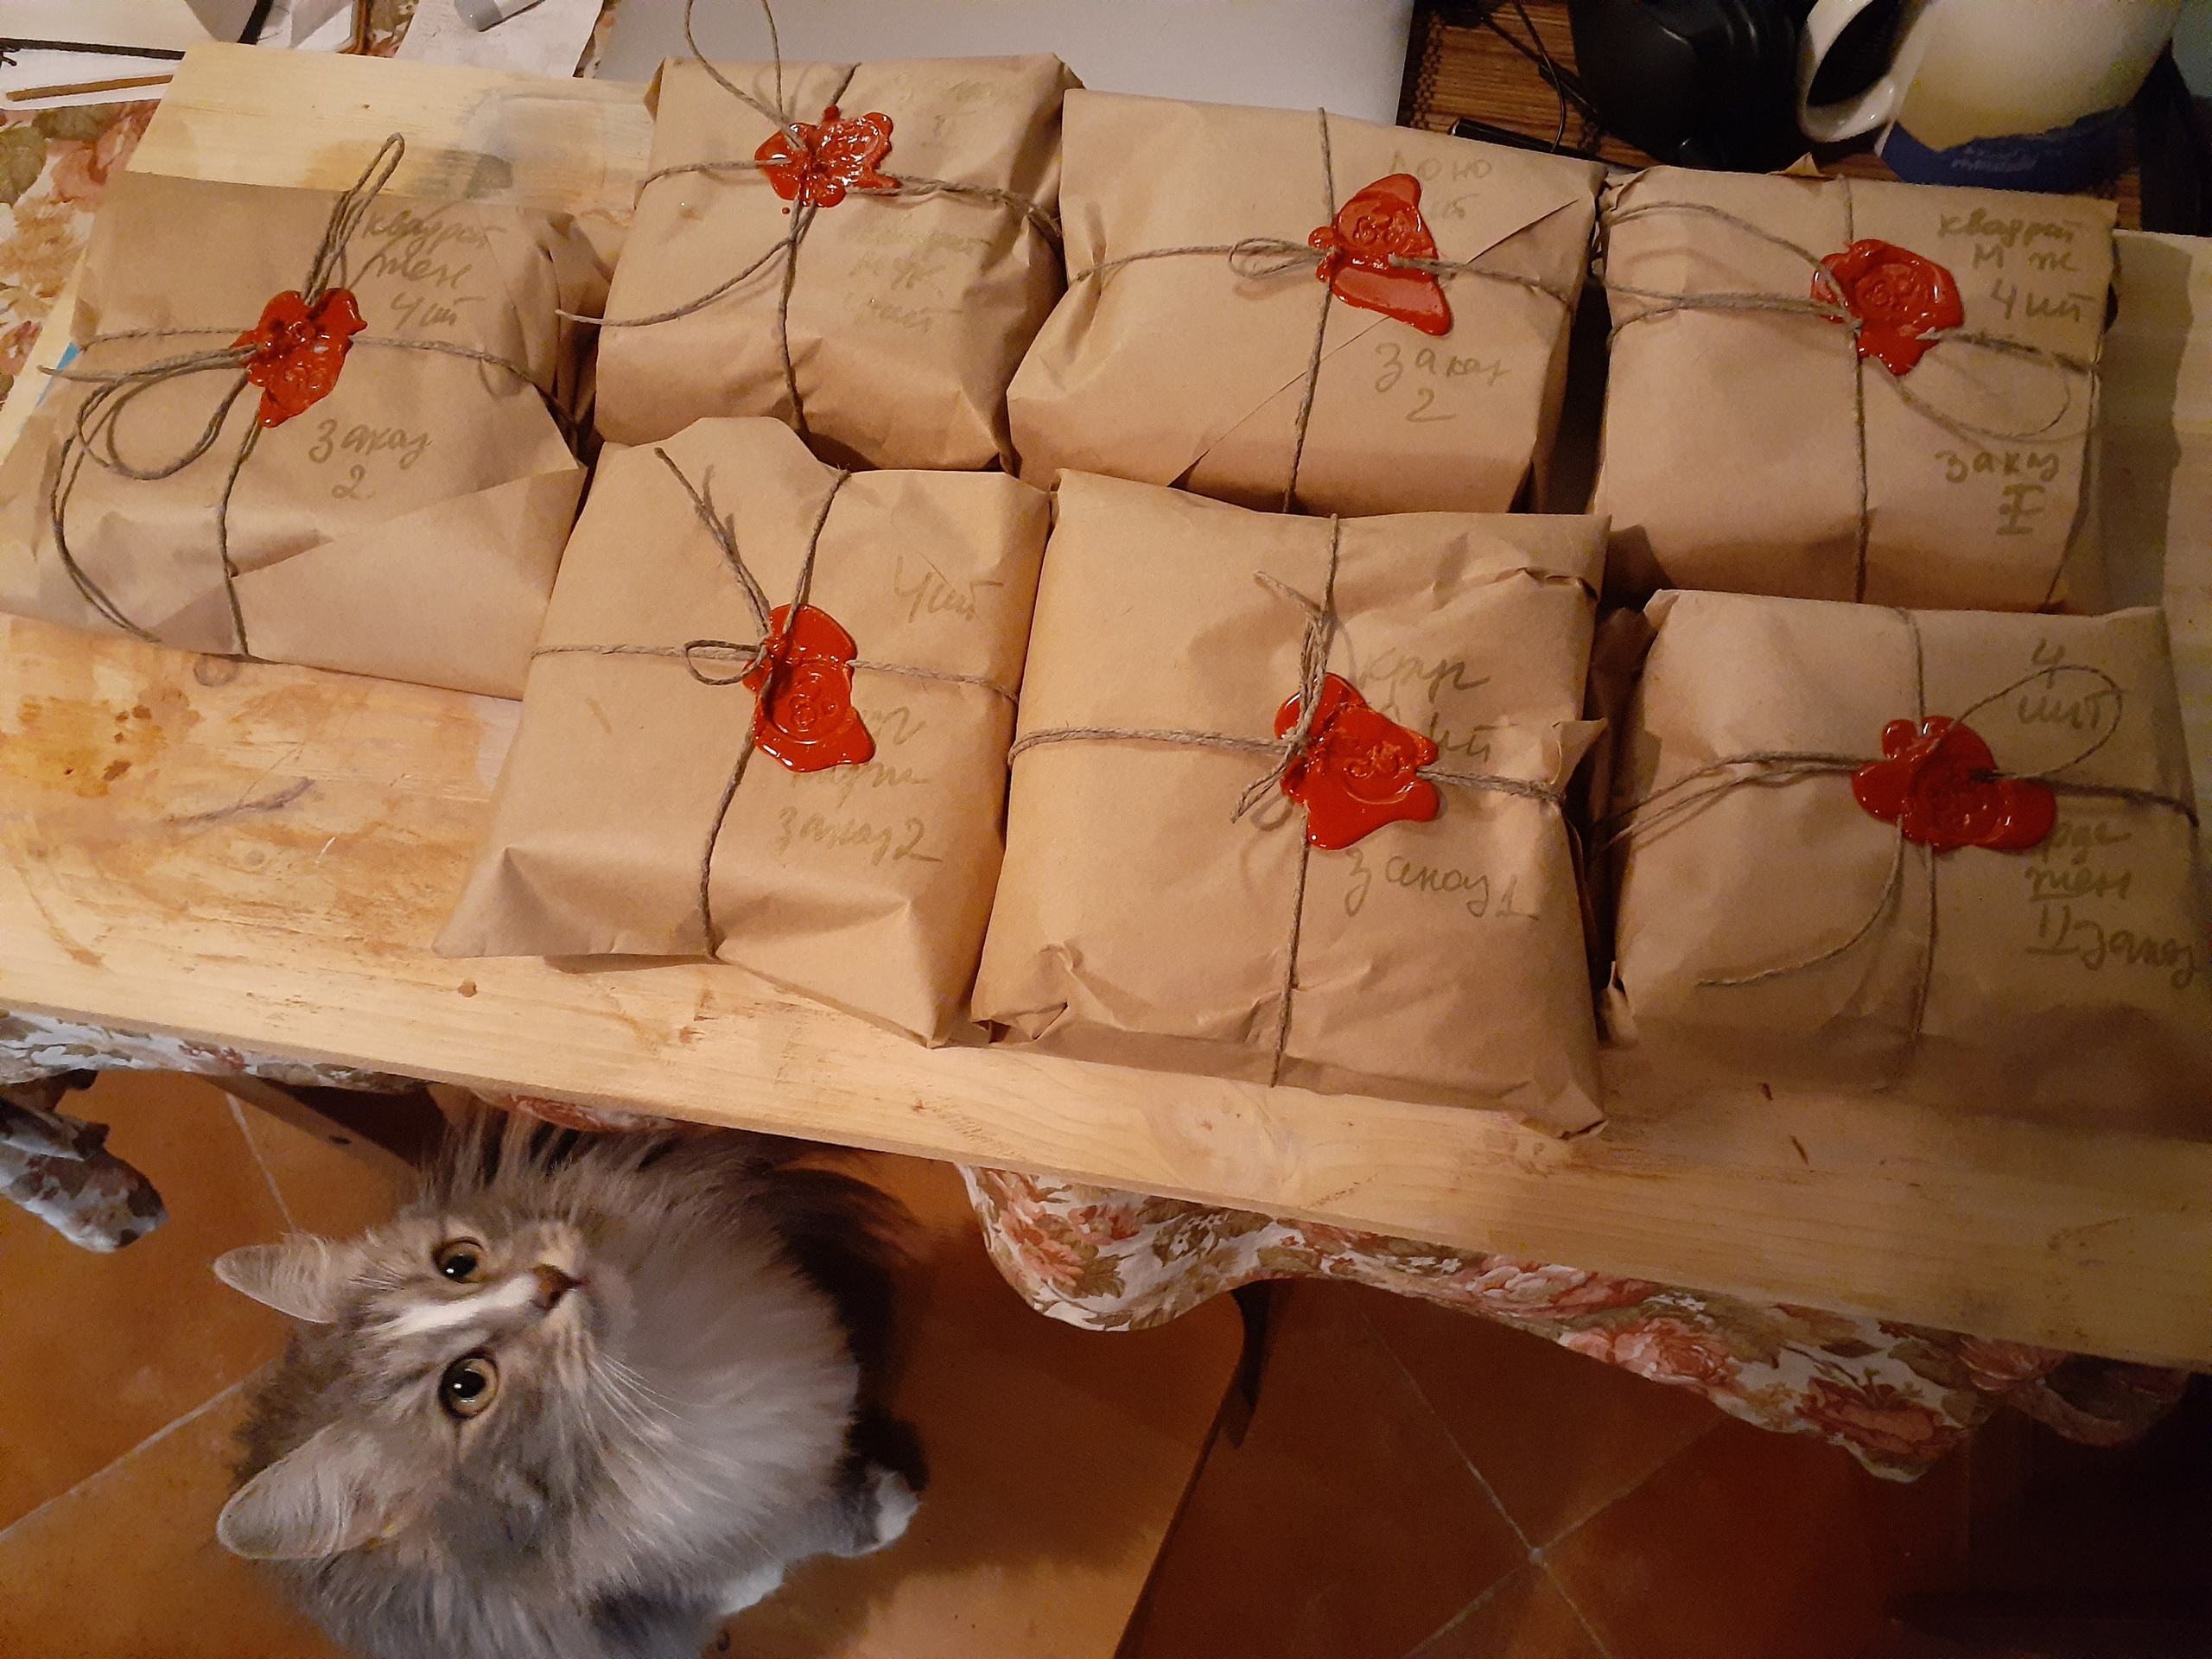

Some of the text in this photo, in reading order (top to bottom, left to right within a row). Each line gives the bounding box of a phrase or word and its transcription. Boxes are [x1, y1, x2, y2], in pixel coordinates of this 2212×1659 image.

[1405, 388, 1456, 423] 2
[330, 464, 376, 499] 2
[893, 817, 943, 862] 2
